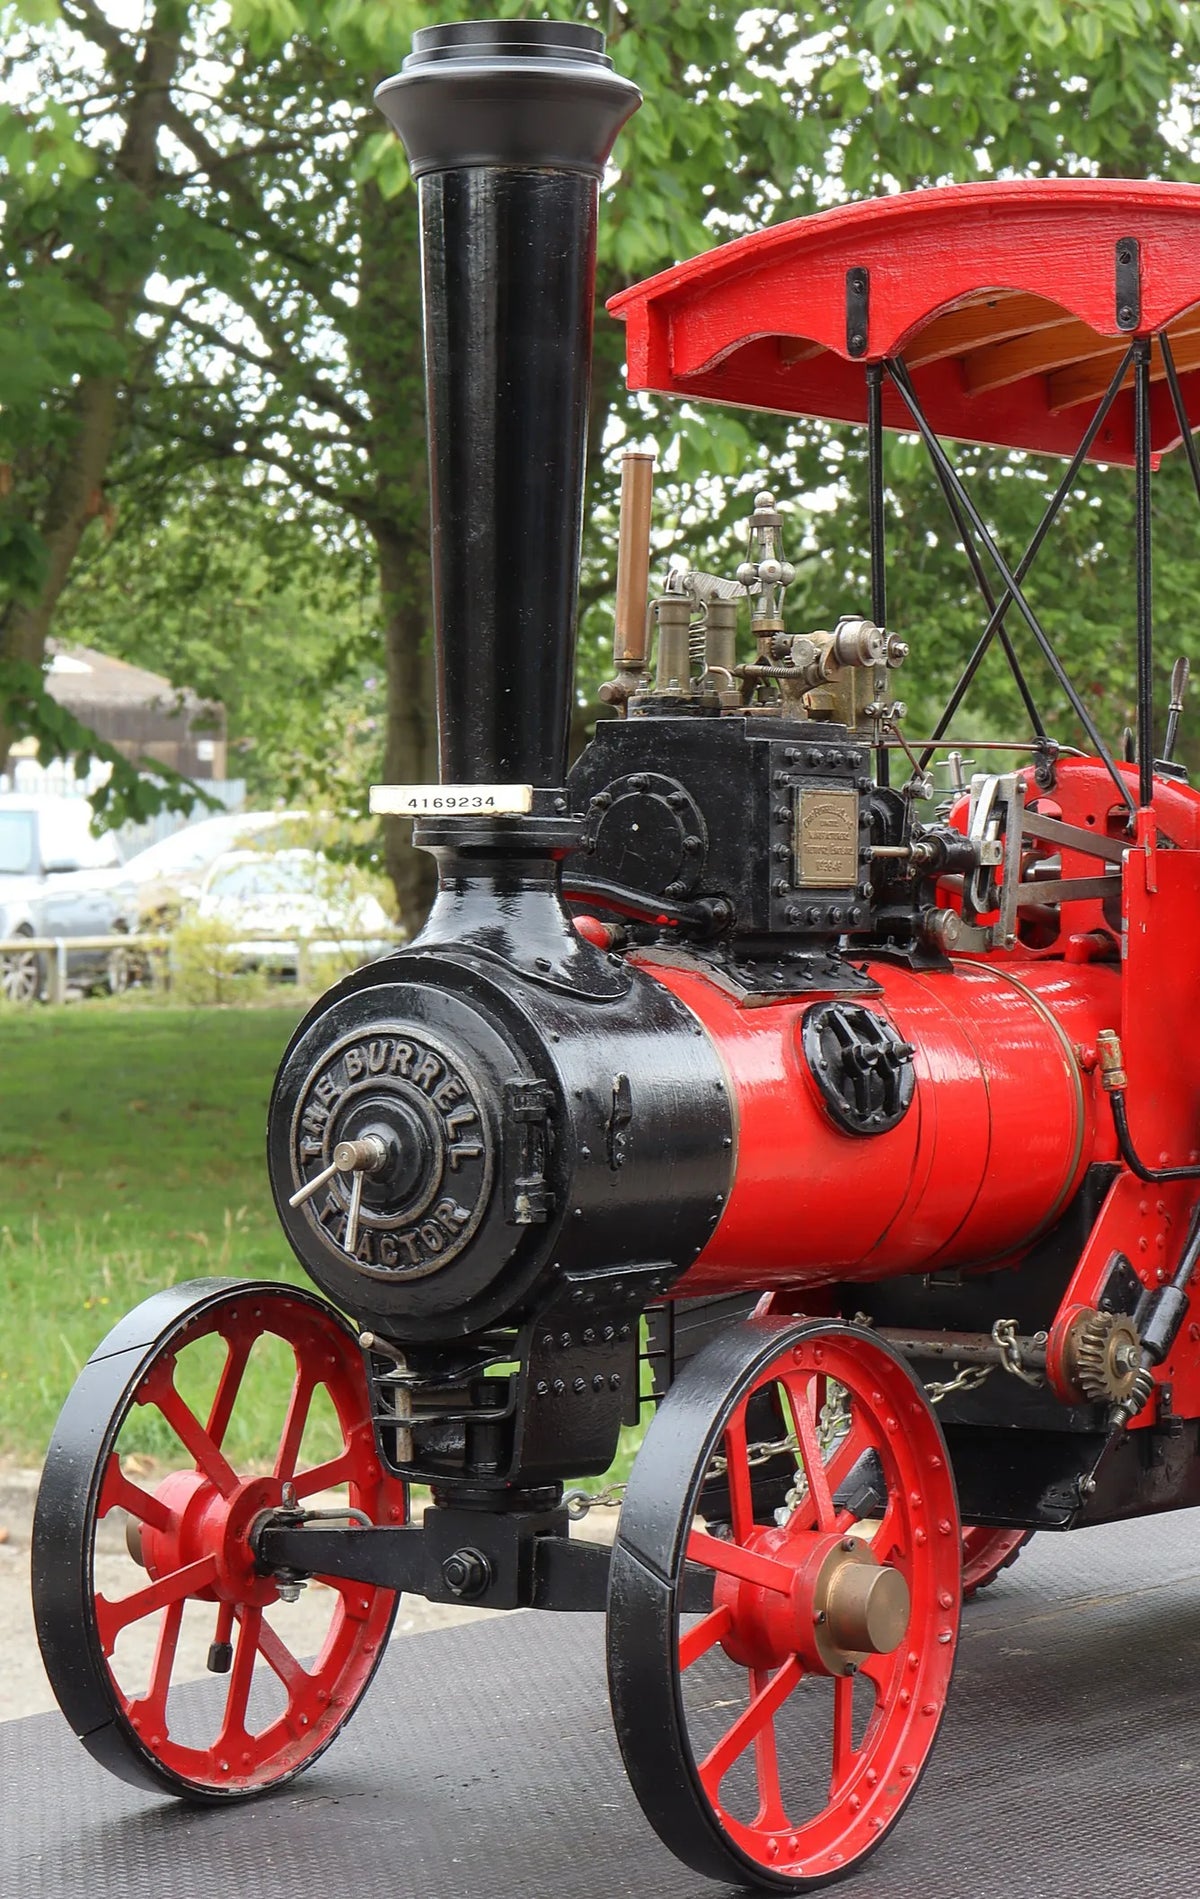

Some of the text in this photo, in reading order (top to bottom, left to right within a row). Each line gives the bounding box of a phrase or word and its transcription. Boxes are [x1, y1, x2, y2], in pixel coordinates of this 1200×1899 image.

[408, 796, 495, 808] 4169234
[300, 1041, 482, 1170] THE BURRELL
